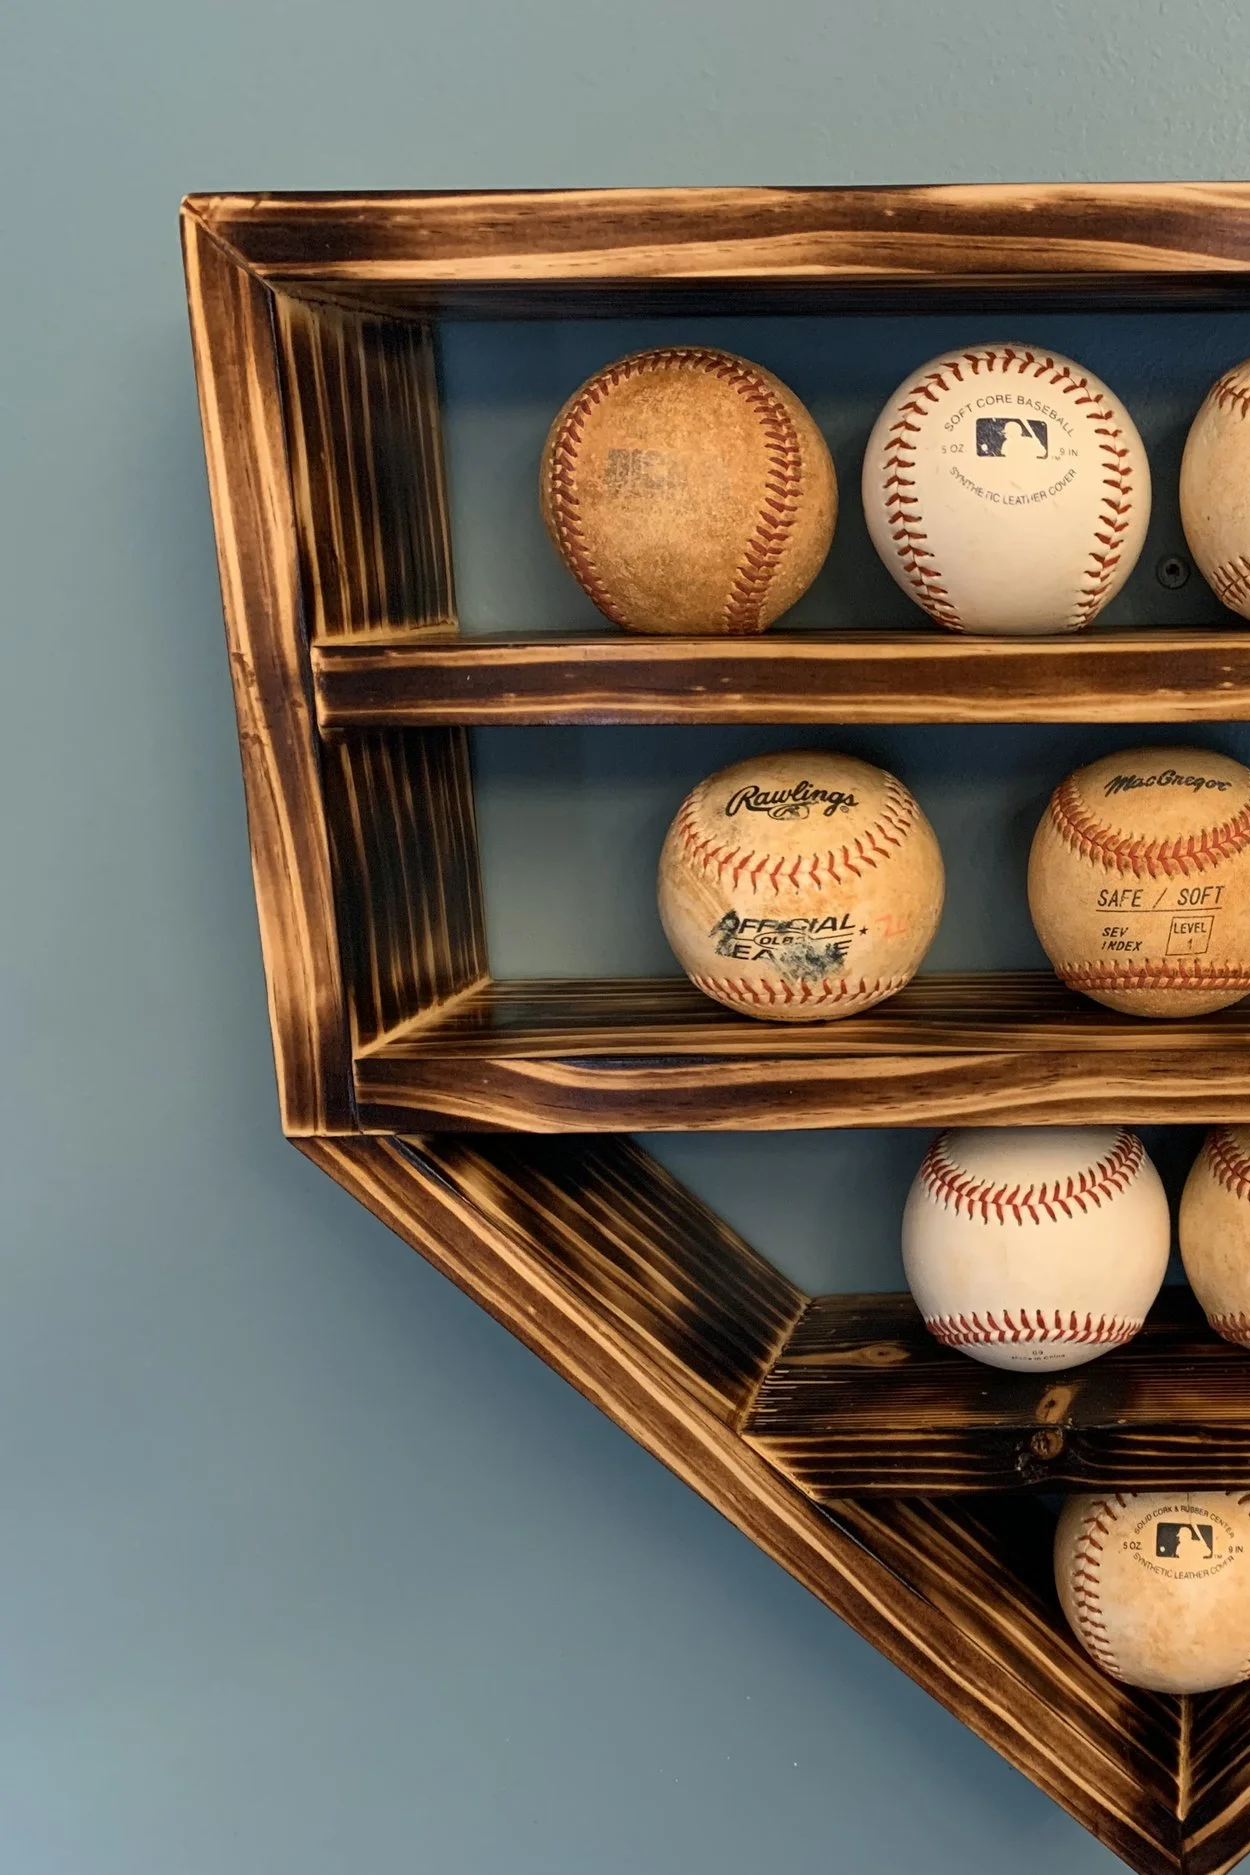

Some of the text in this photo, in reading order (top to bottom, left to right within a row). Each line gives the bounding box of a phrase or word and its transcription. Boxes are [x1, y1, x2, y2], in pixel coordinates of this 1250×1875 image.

[944, 394, 1076, 437] SOFT CORE BASEBALL
[950, 444, 964, 453] OZ
[1060, 447, 1078, 457] 9 IN
[949, 466, 1077, 506] SYNTHETIC LEATHER COVER
[1104, 769, 1232, 797] MacGregor
[725, 780, 859, 817] Rawlings
[1097, 889, 1144, 908] SAFE
[1177, 885, 1225, 906] SOFT
[1102, 927, 1129, 938] SEV
[1173, 922, 1207, 934] LEVEL
[1101, 940, 1143, 952] INDEX
[1134, 1513, 1152, 1535] SOLID
[1152, 1506, 1173, 1518] CORK
[1180, 1505, 1209, 1517] RUBBER
[1209, 1513, 1236, 1539] CENTER
[1123, 1541, 1128, 1550] 5
[1235, 1546, 1244, 1554] IN
[1133, 1552, 1235, 1580] SYNTHETIC LEATHER COVER
